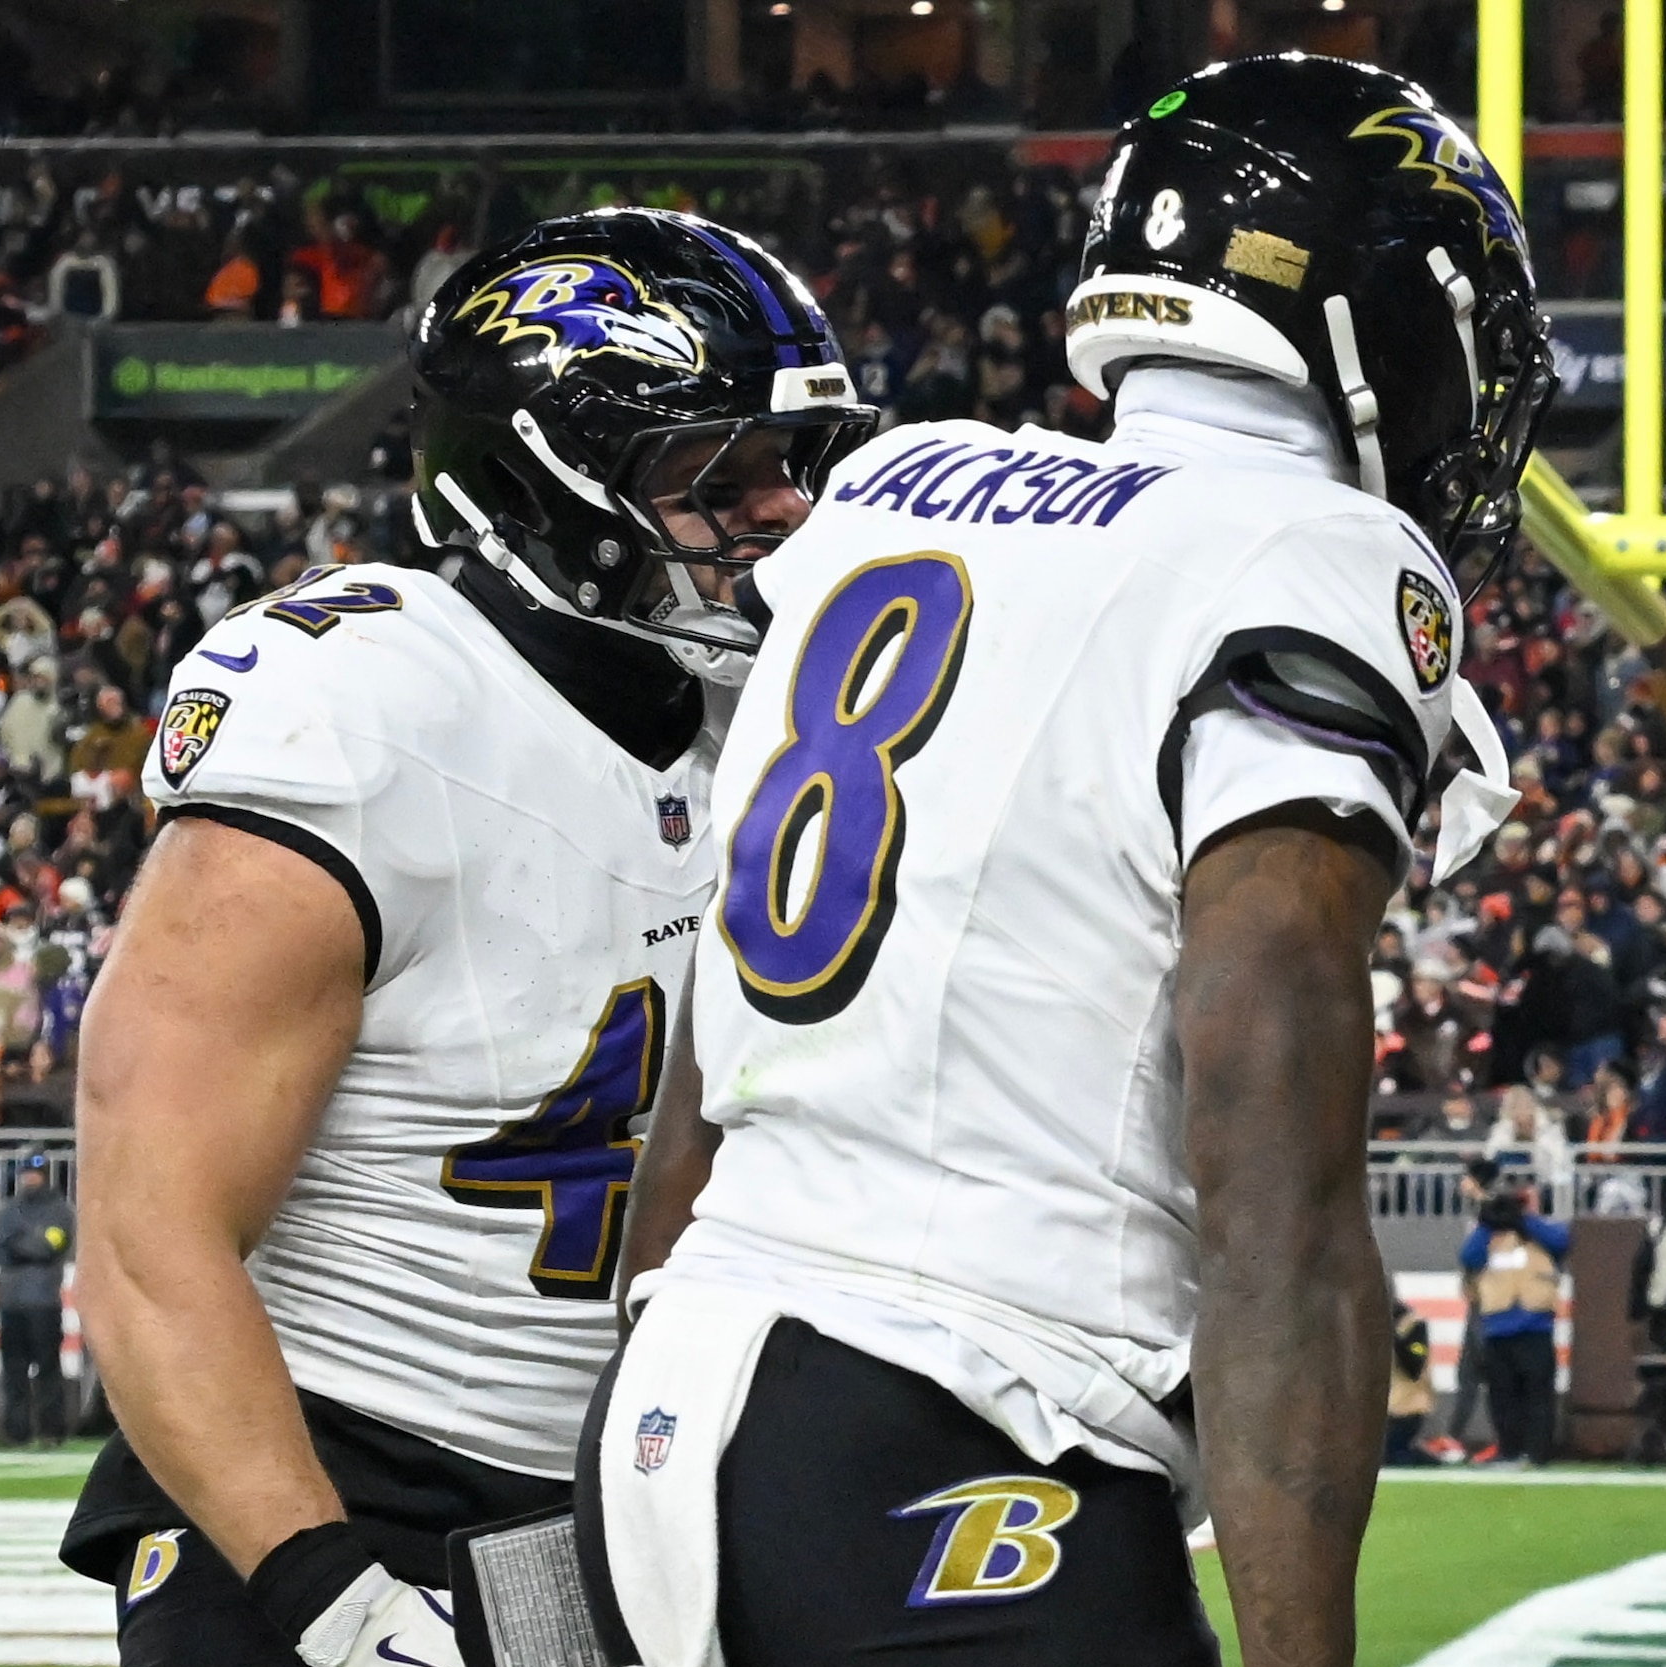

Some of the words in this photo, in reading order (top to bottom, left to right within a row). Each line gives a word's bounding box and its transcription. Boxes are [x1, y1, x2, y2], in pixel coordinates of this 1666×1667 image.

[1145, 188, 1186, 251] 8
[834, 439, 1183, 528] JACKSON
[176, 689, 227, 709] RAVENS
[717, 550, 974, 1026] 8
[888, 1473, 1081, 1609] B
